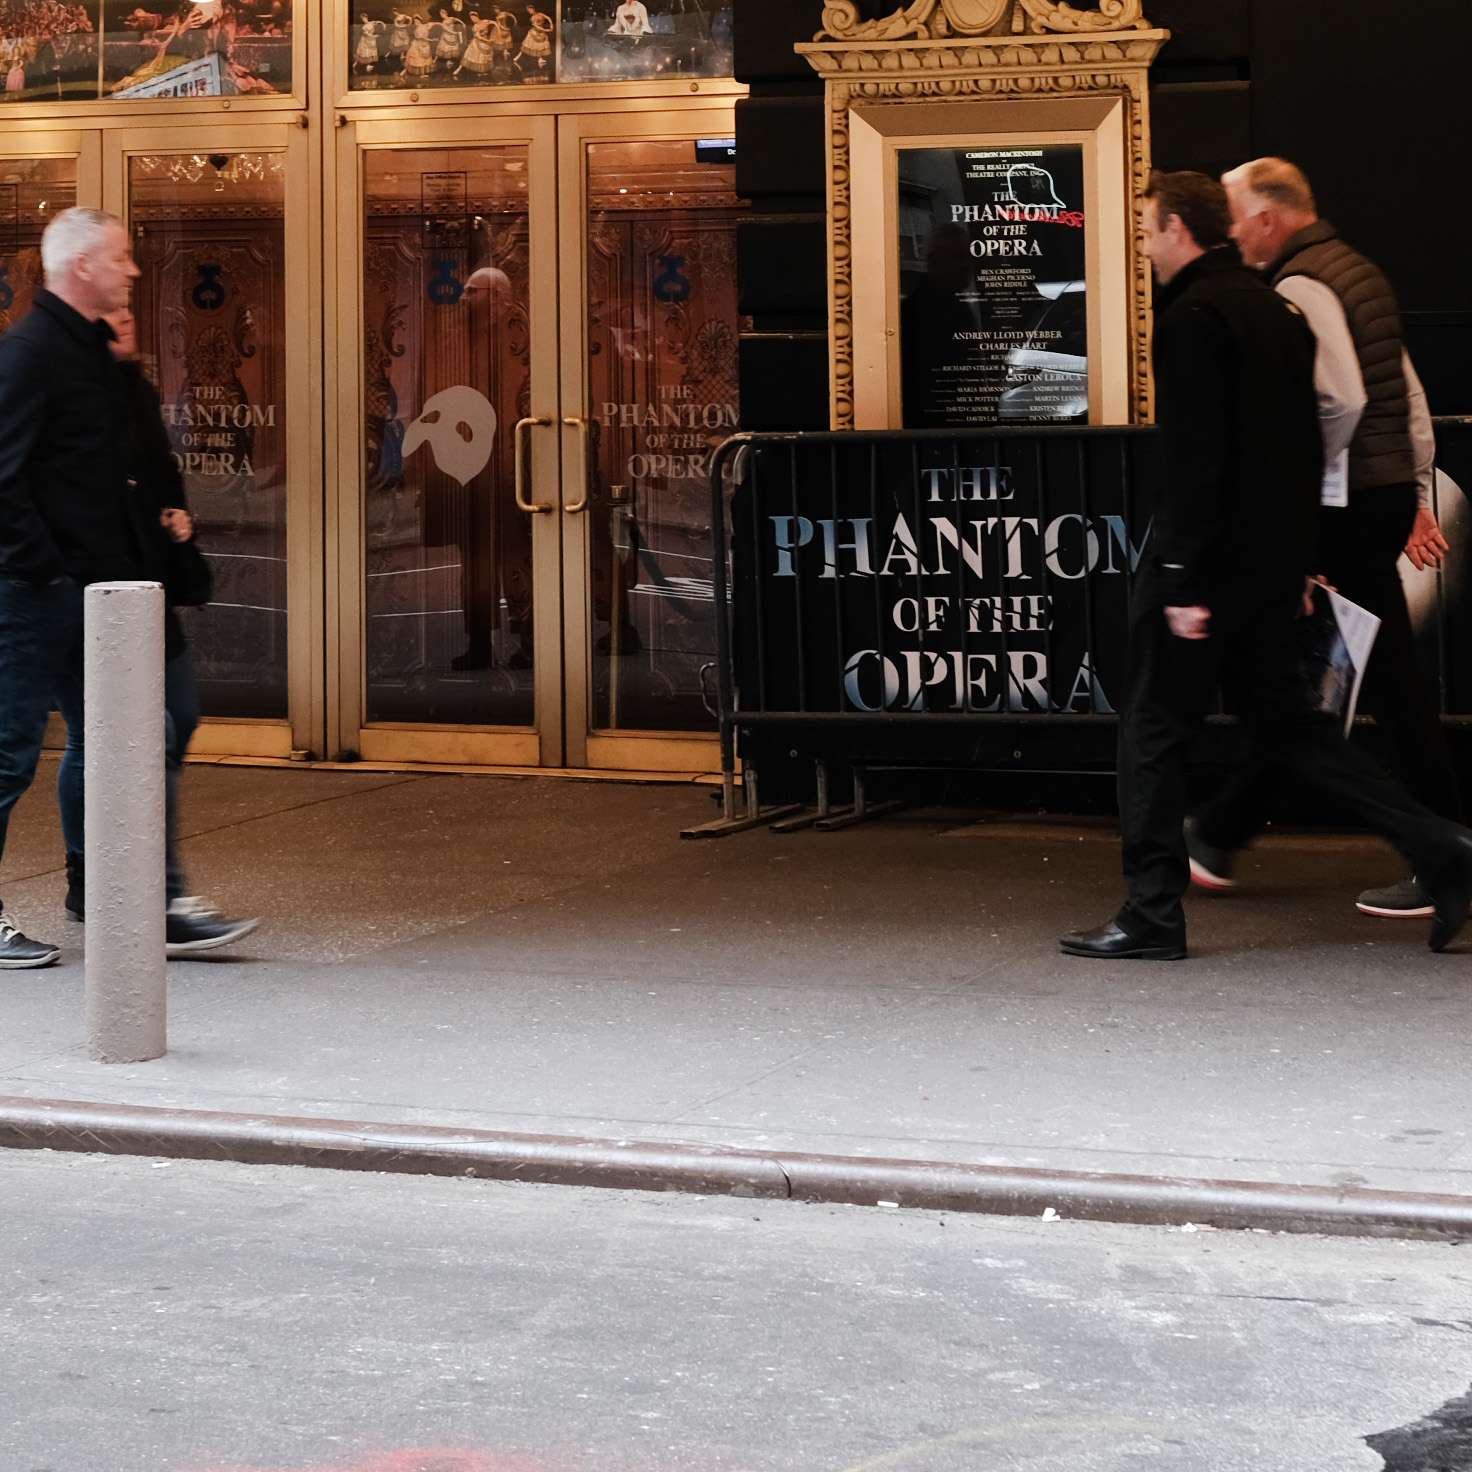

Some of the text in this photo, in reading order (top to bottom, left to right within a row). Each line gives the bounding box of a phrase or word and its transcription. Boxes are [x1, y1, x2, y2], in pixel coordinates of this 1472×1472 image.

[992, 191, 1017, 202] THE
[951, 203, 1059, 222] PHANTOM
[983, 224, 1028, 236] OF THE
[970, 239, 1043, 257] OPERA
[953, 330, 1063, 340] ANDREW LLOYD WEBBER
[192, 386, 226, 400] THE
[658, 385, 694, 399] THE
[160, 403, 277, 428] HANTOM
[182, 432, 236, 447] OF THE
[646, 434, 706, 448] OF THE
[628, 454, 710, 478] OPER
[922, 466, 1015, 502] THE
[892, 595, 1053, 633] OF THE
[843, 649, 1118, 713] OPERA
